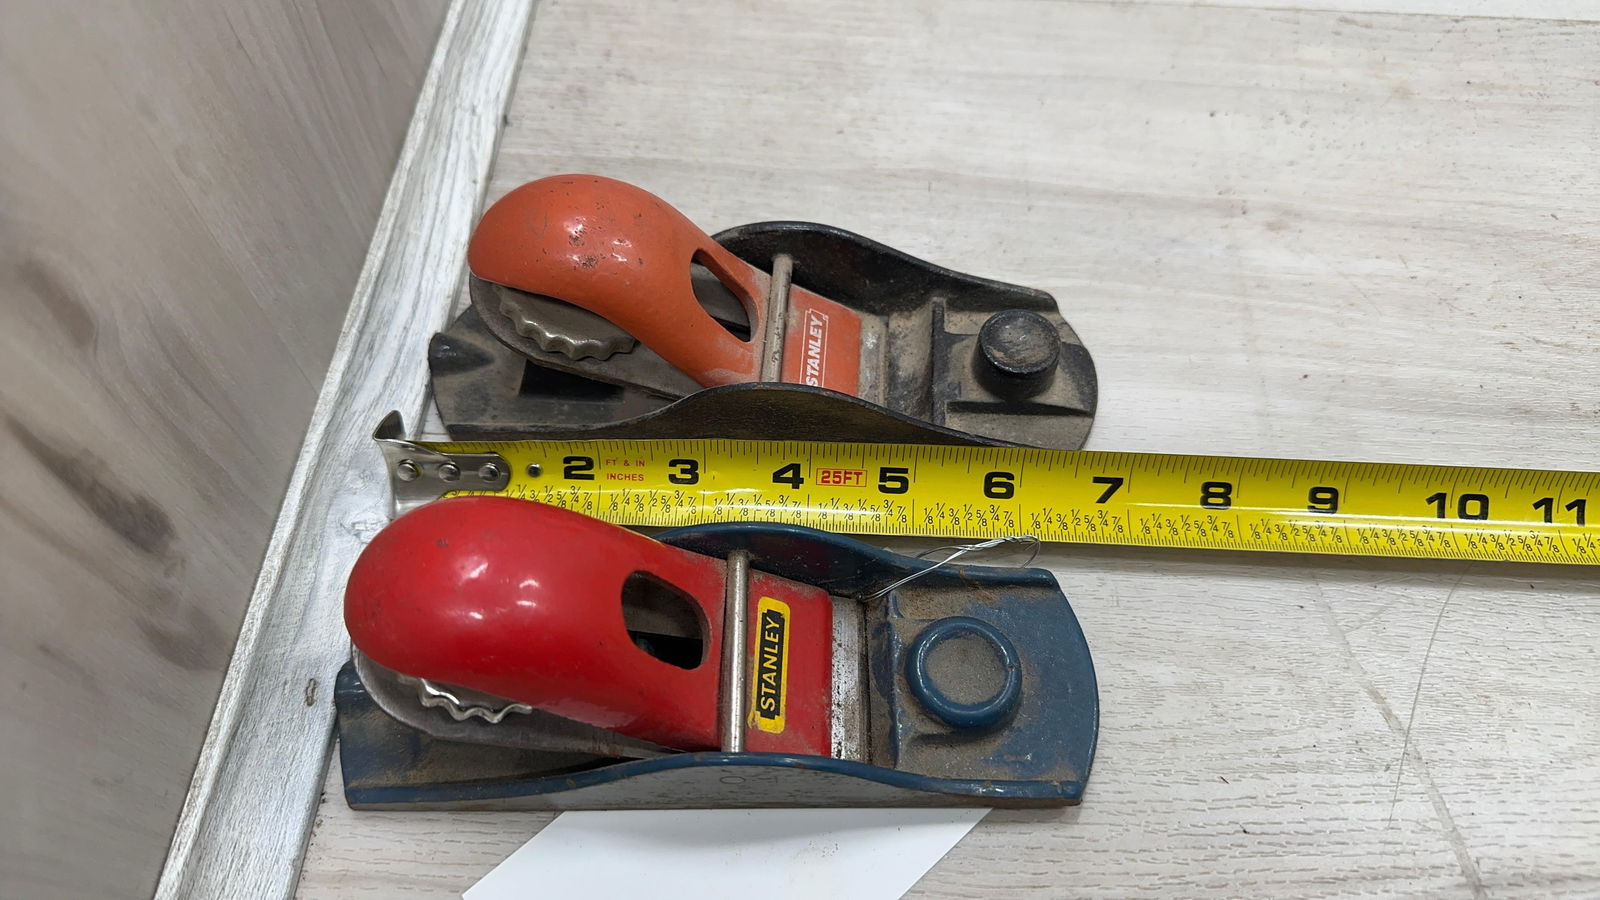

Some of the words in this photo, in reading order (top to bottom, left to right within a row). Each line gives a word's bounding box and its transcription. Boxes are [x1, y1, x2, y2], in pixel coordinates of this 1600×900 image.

[806, 314, 823, 387] STANLEY
[562, 456, 595, 480] 2
[668, 459, 699, 485] 3
[772, 463, 804, 489] 4
[878, 467, 909, 494] 5
[983, 471, 1015, 499] 6
[1092, 476, 1124, 504] 7
[1200, 481, 1232, 510] 8
[1307, 487, 1339, 514] 9
[1425, 492, 1489, 520] 10
[1532, 497, 1587, 527] 11
[606, 473, 645, 481] INCHES
[821, 470, 862, 485] 25FT
[760, 616, 780, 712] STANLEY
